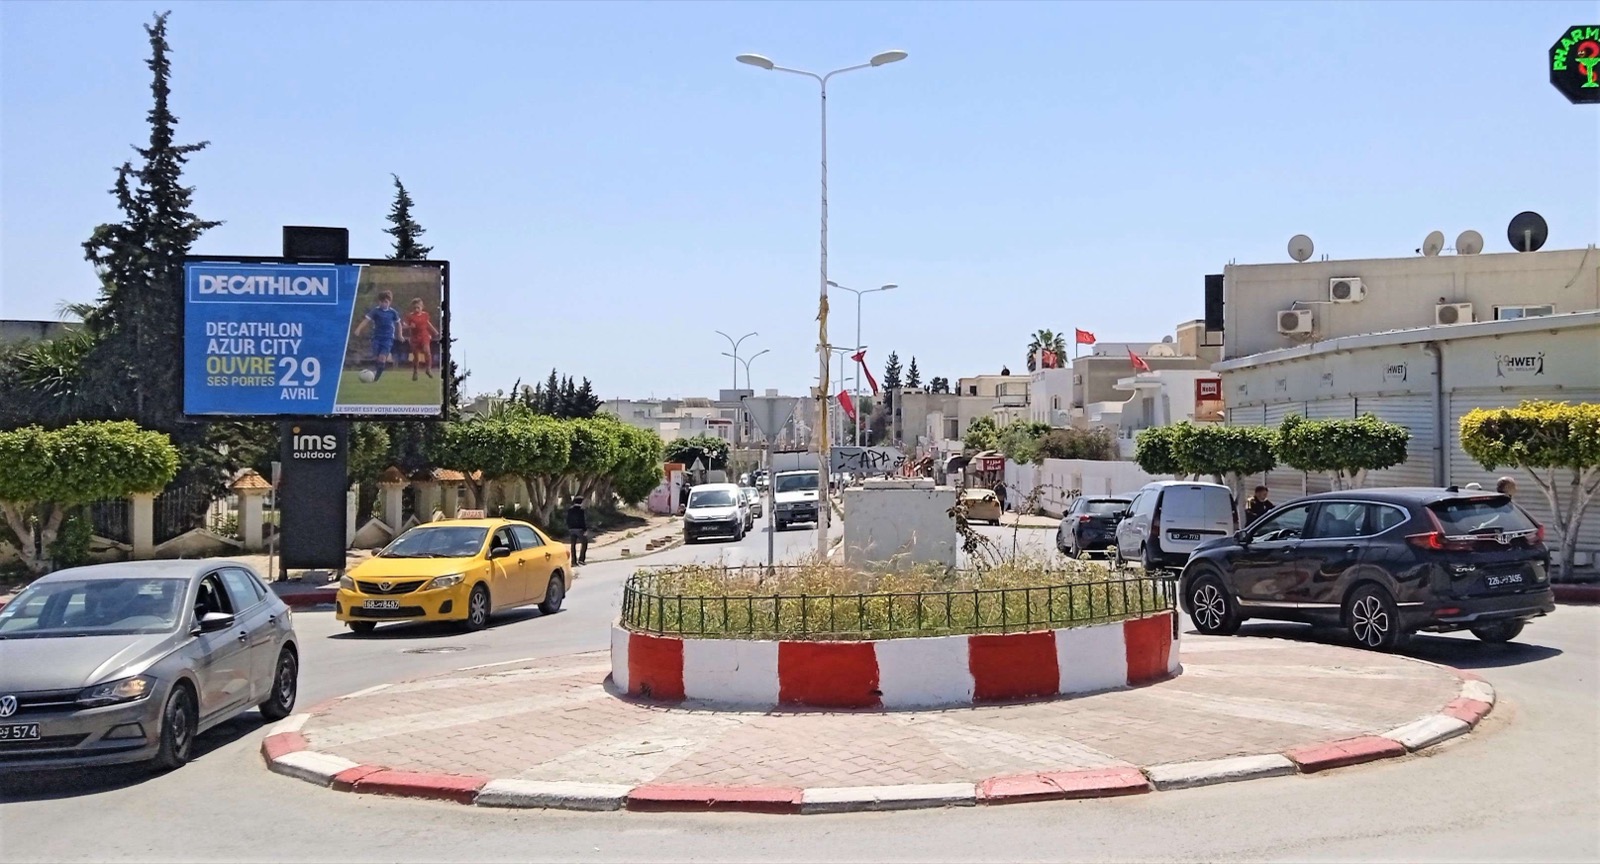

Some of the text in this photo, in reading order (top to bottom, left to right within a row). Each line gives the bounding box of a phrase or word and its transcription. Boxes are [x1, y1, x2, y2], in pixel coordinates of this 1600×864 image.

[1553, 27, 1600, 70] PHARM
[199, 275, 329, 296] DECATHLON
[206, 321, 303, 337] DECATHLON
[206, 338, 302, 355] AZUR CITY
[206, 356, 275, 374] OUVRE
[278, 356, 321, 387] 29
[206, 376, 275, 387] SES PORTES
[280, 387, 319, 400] AVRIL
[293, 425, 337, 450] ims
[293, 451, 337, 459] outdoor
[13, 725, 37, 738] 574
